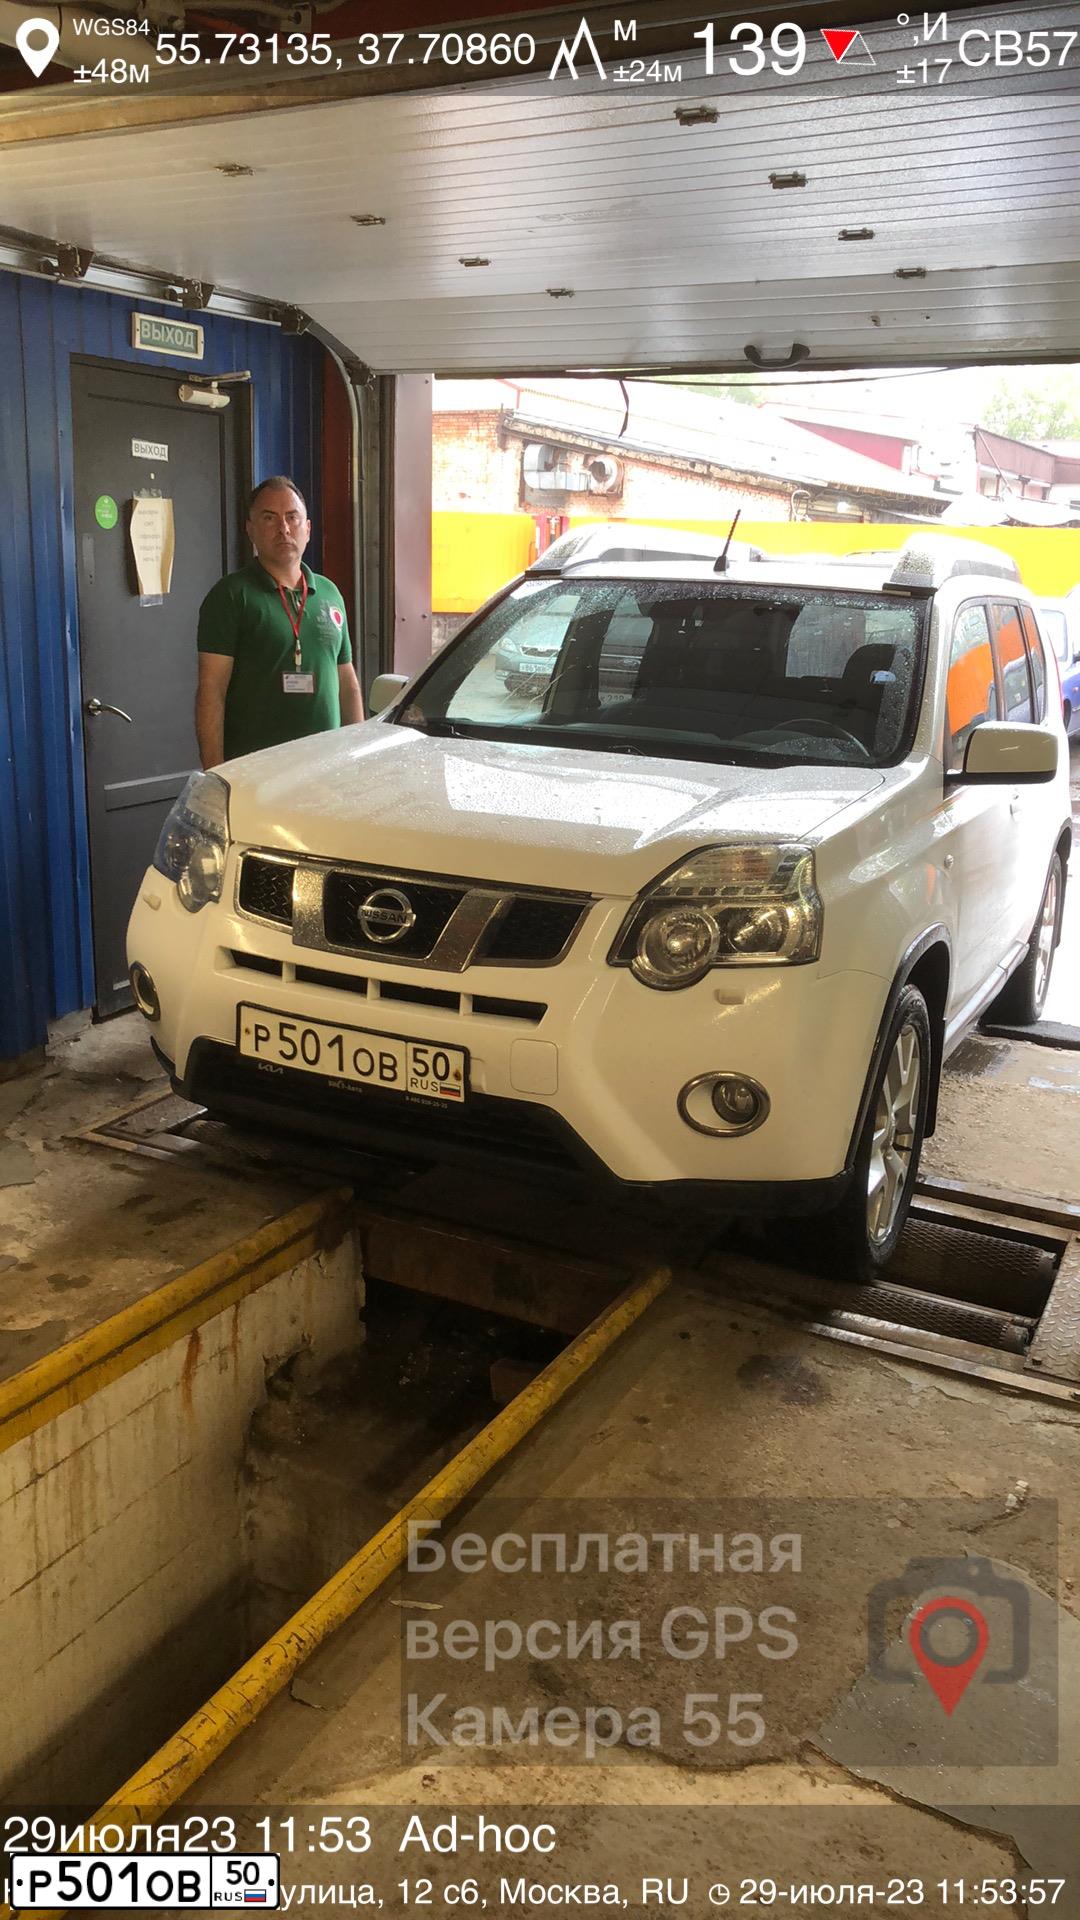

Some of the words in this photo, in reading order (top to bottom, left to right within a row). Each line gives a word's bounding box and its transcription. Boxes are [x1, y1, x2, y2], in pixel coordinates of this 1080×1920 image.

[141, 320, 195, 349] ВЫХОД
[134, 443, 166, 459] ВЫХОД
[361, 908, 408, 924] NISSAN
[412, 1047, 450, 1081] 50
[410, 1077, 439, 1092] RUS
